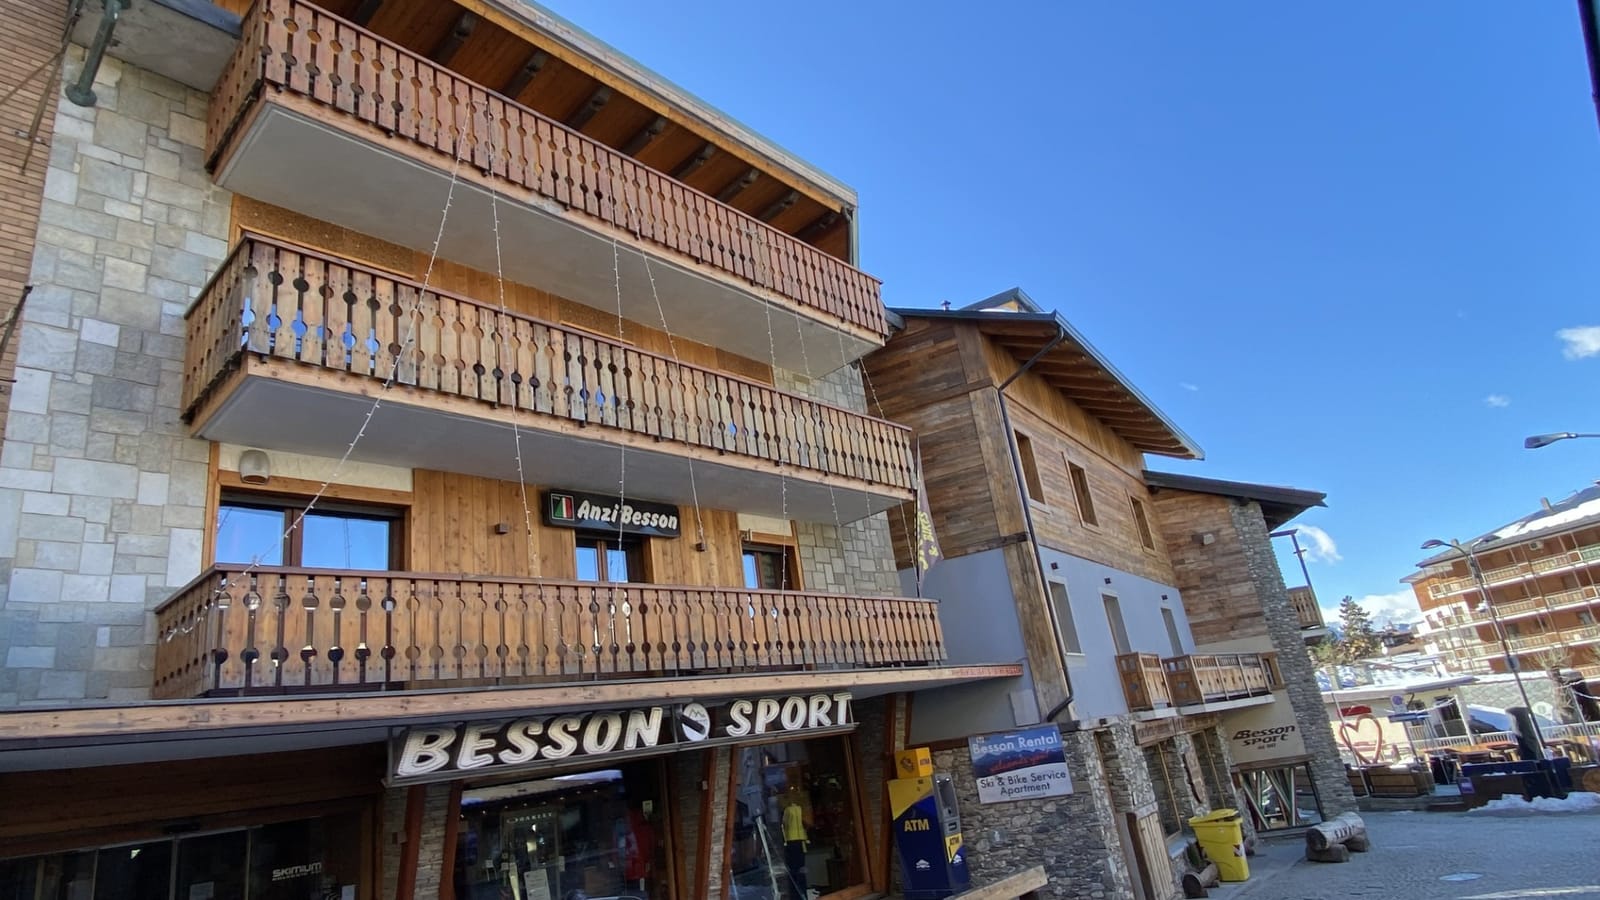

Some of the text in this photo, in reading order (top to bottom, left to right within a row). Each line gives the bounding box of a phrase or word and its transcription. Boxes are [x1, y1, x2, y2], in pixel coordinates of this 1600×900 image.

[577, 499, 678, 530] Anzi Besson
[397, 692, 853, 777] BESSON SPORT
[973, 731, 1058, 754] Besson Rental
[1233, 725, 1296, 741] Besson
[980, 770, 1067, 789] Ski & Bike Service
[1000, 782, 1050, 797] Apartment
[904, 819, 930, 832] ATM
